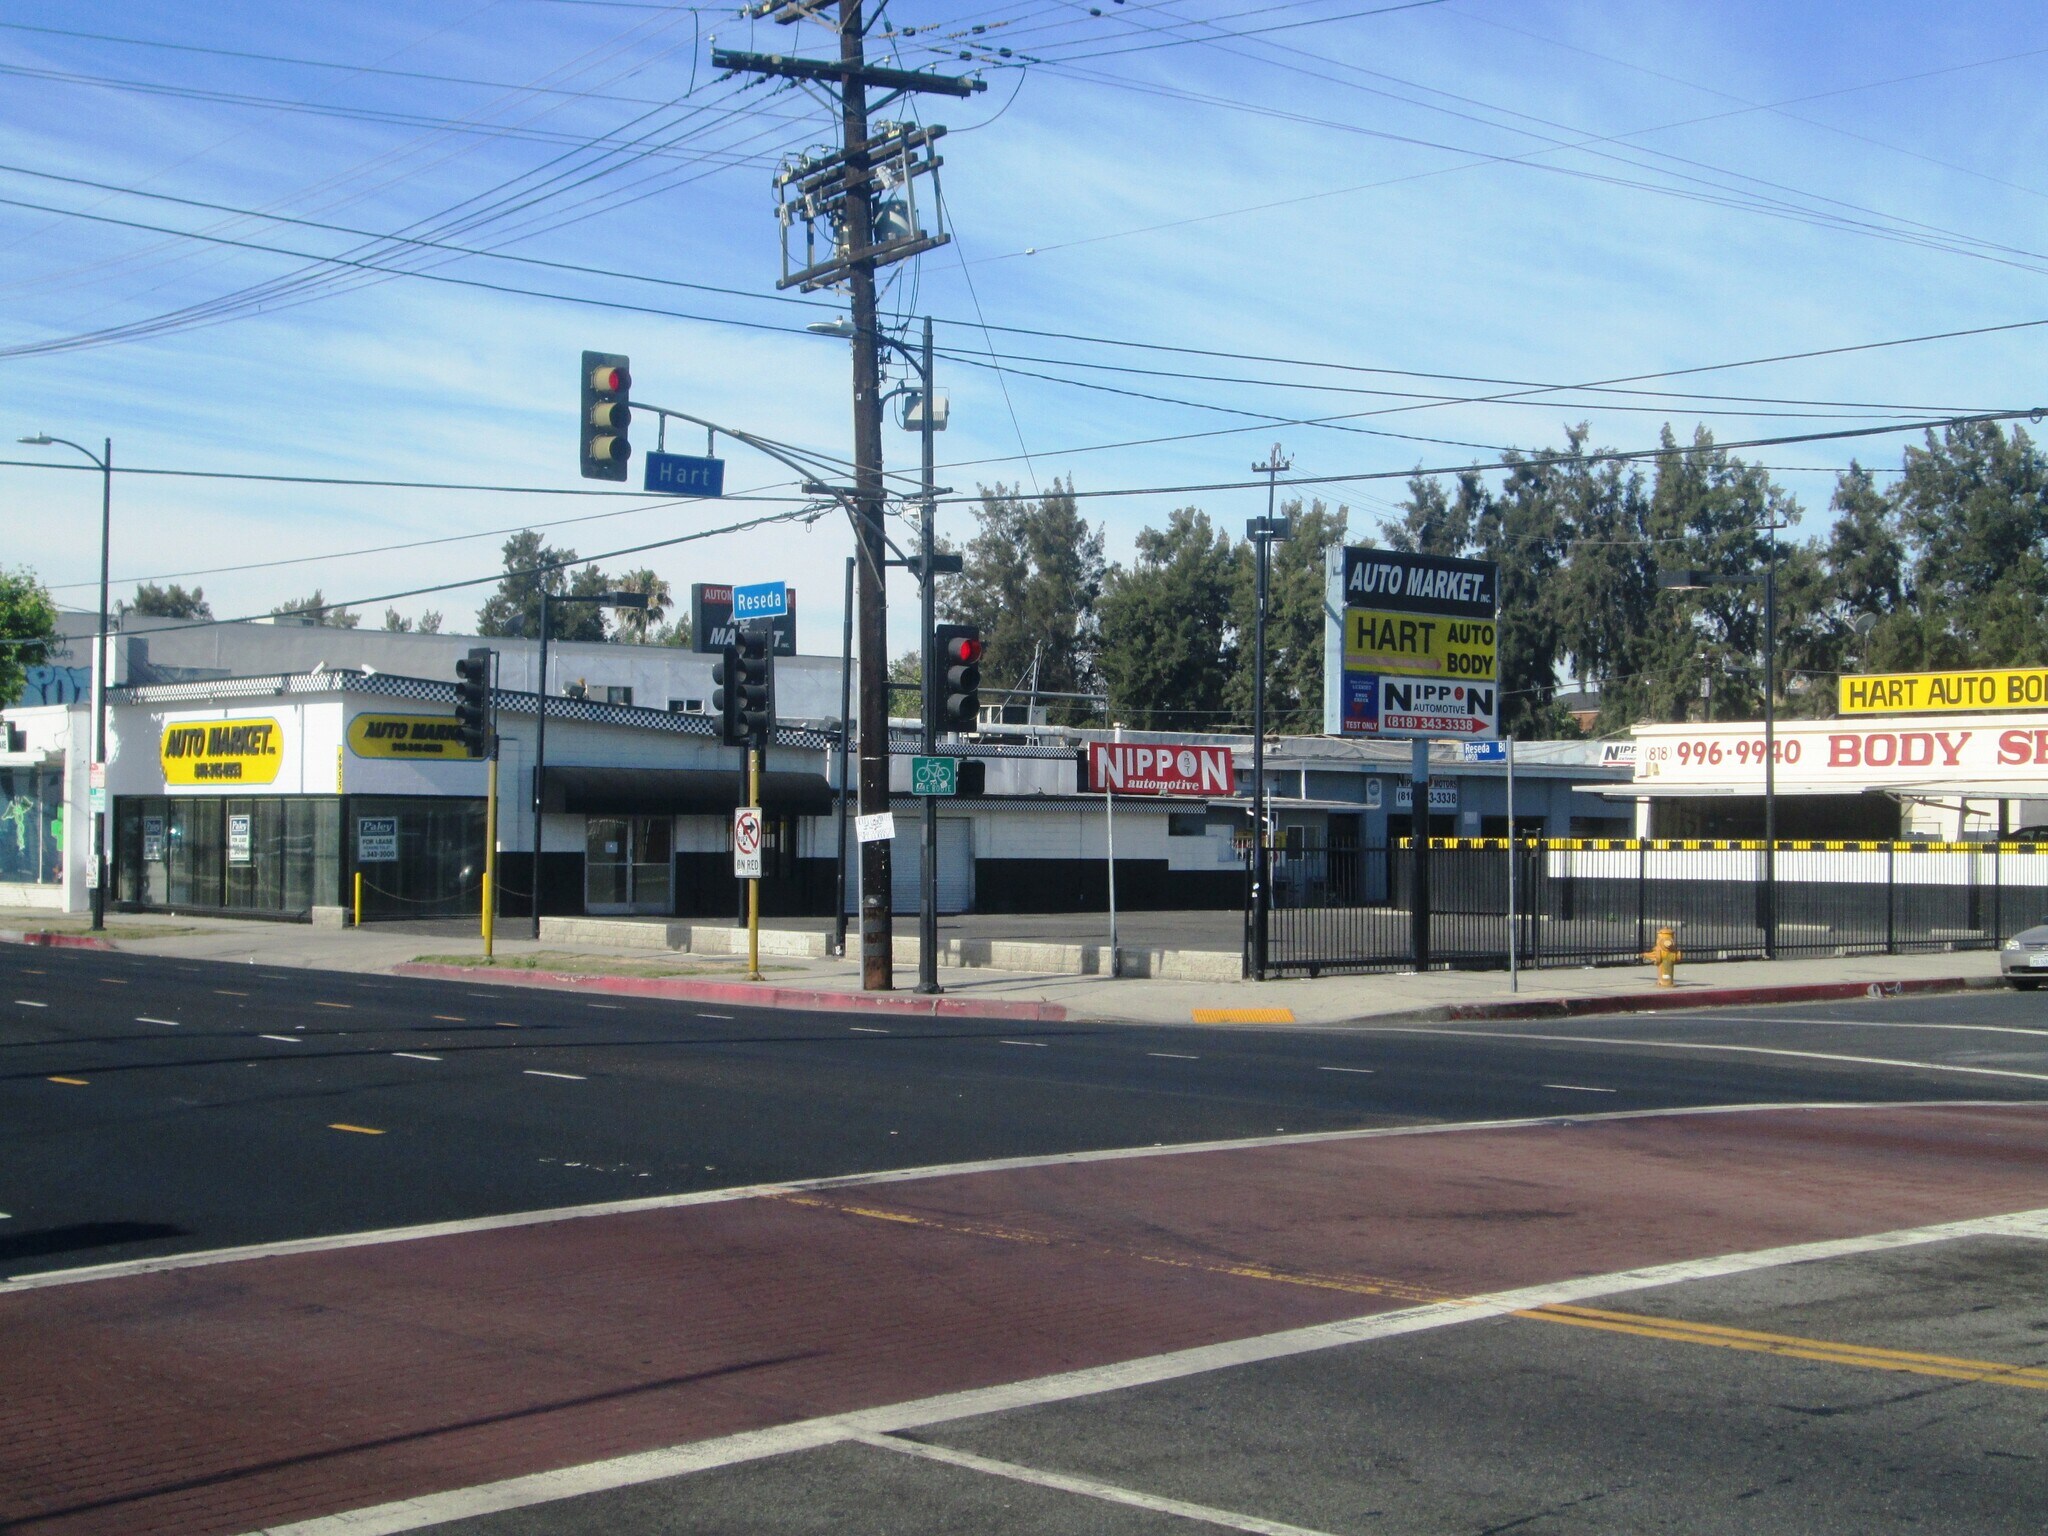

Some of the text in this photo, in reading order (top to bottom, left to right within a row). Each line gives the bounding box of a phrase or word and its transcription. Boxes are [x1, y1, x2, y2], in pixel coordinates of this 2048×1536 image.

[660, 462, 709, 486] Hart
[1349, 562, 1403, 595] AUTO
[1406, 567, 1484, 602] MARKET
[738, 590, 781, 611] Reseda
[1357, 617, 1494, 654] HART AUTO
[1447, 653, 1494, 676] BODY
[1385, 683, 1494, 716] NIPPON
[1849, 673, 2048, 708] HART AUTO BO
[1413, 703, 1465, 715] AUTOMOTIVE
[363, 721, 409, 740] AUTO
[1346, 720, 1378, 730] TEST ONLY
[1387, 716, 1473, 731] (818) 343-3338
[164, 728, 206, 759] AUTO
[206, 725, 273, 757] MARKET
[1465, 743, 1490, 754] Reseda
[1645, 746, 1673, 761] (818)
[1827, 731, 1973, 767] BODY
[1097, 746, 1228, 791] NIPPON
[1127, 778, 1200, 791] automotive
[231, 821, 247, 832] Paley
[363, 821, 393, 832] Paley
[747, 860, 759, 870] RED
